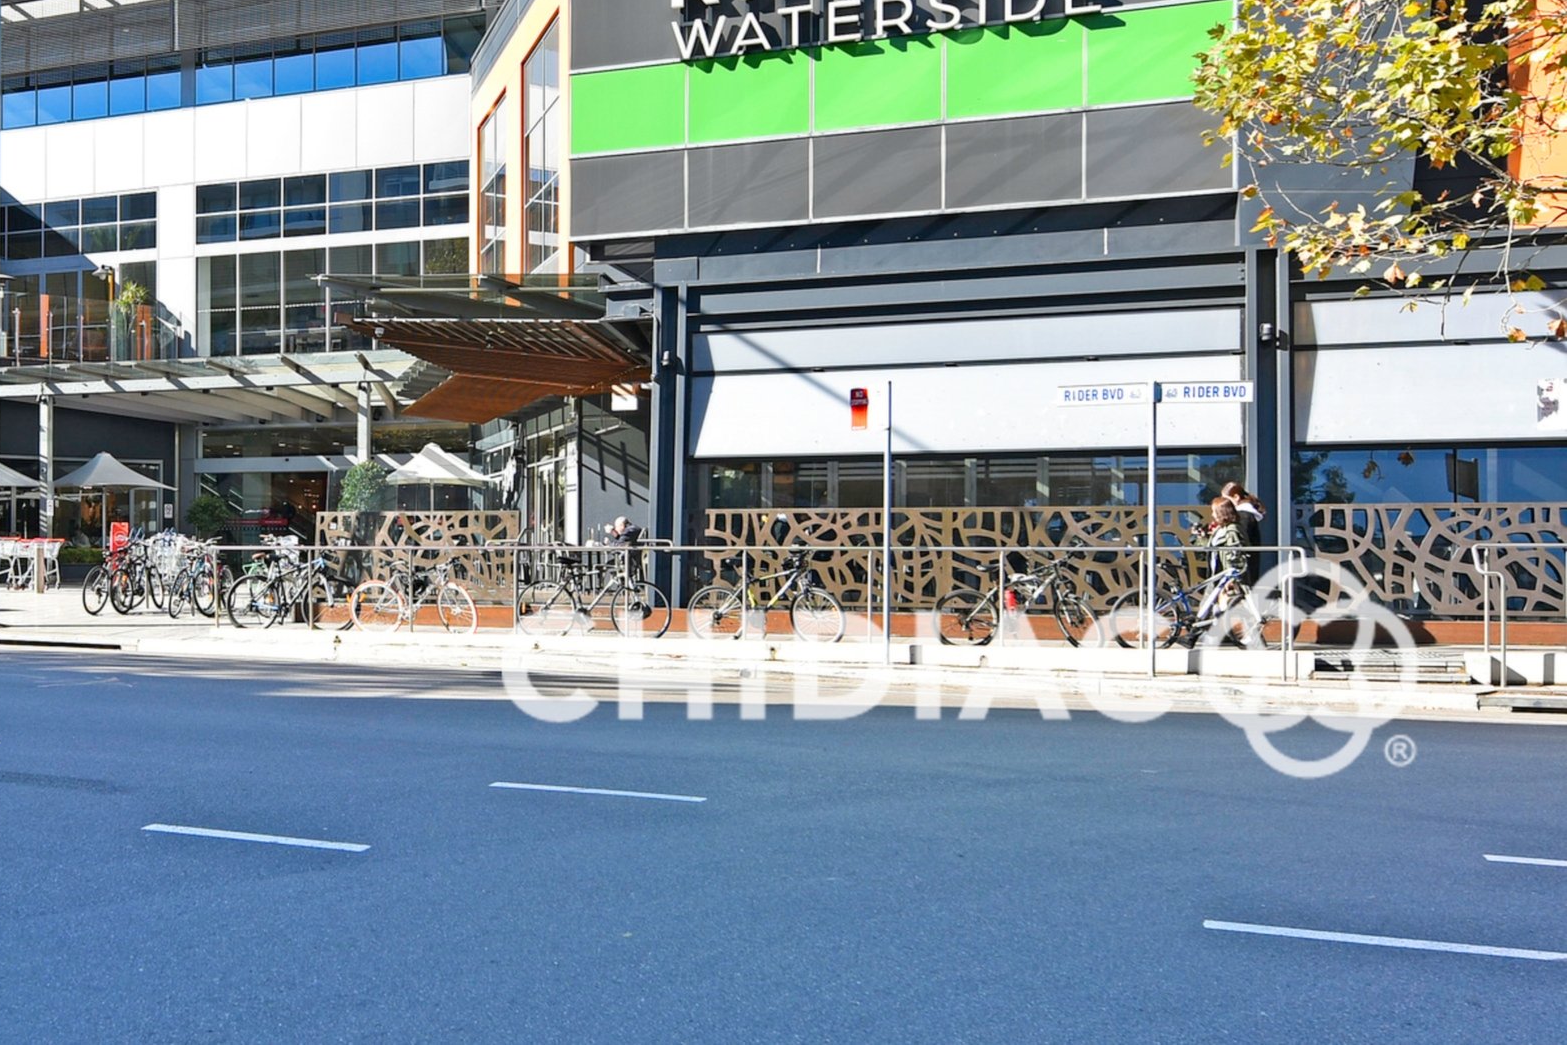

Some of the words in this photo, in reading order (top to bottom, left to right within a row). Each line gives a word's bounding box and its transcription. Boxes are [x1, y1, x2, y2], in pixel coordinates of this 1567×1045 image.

[1064, 388, 1099, 402] RIDER
[1102, 388, 1124, 401] BVD
[1183, 385, 1220, 399] RIDER
[1223, 385, 1246, 398] BVD
